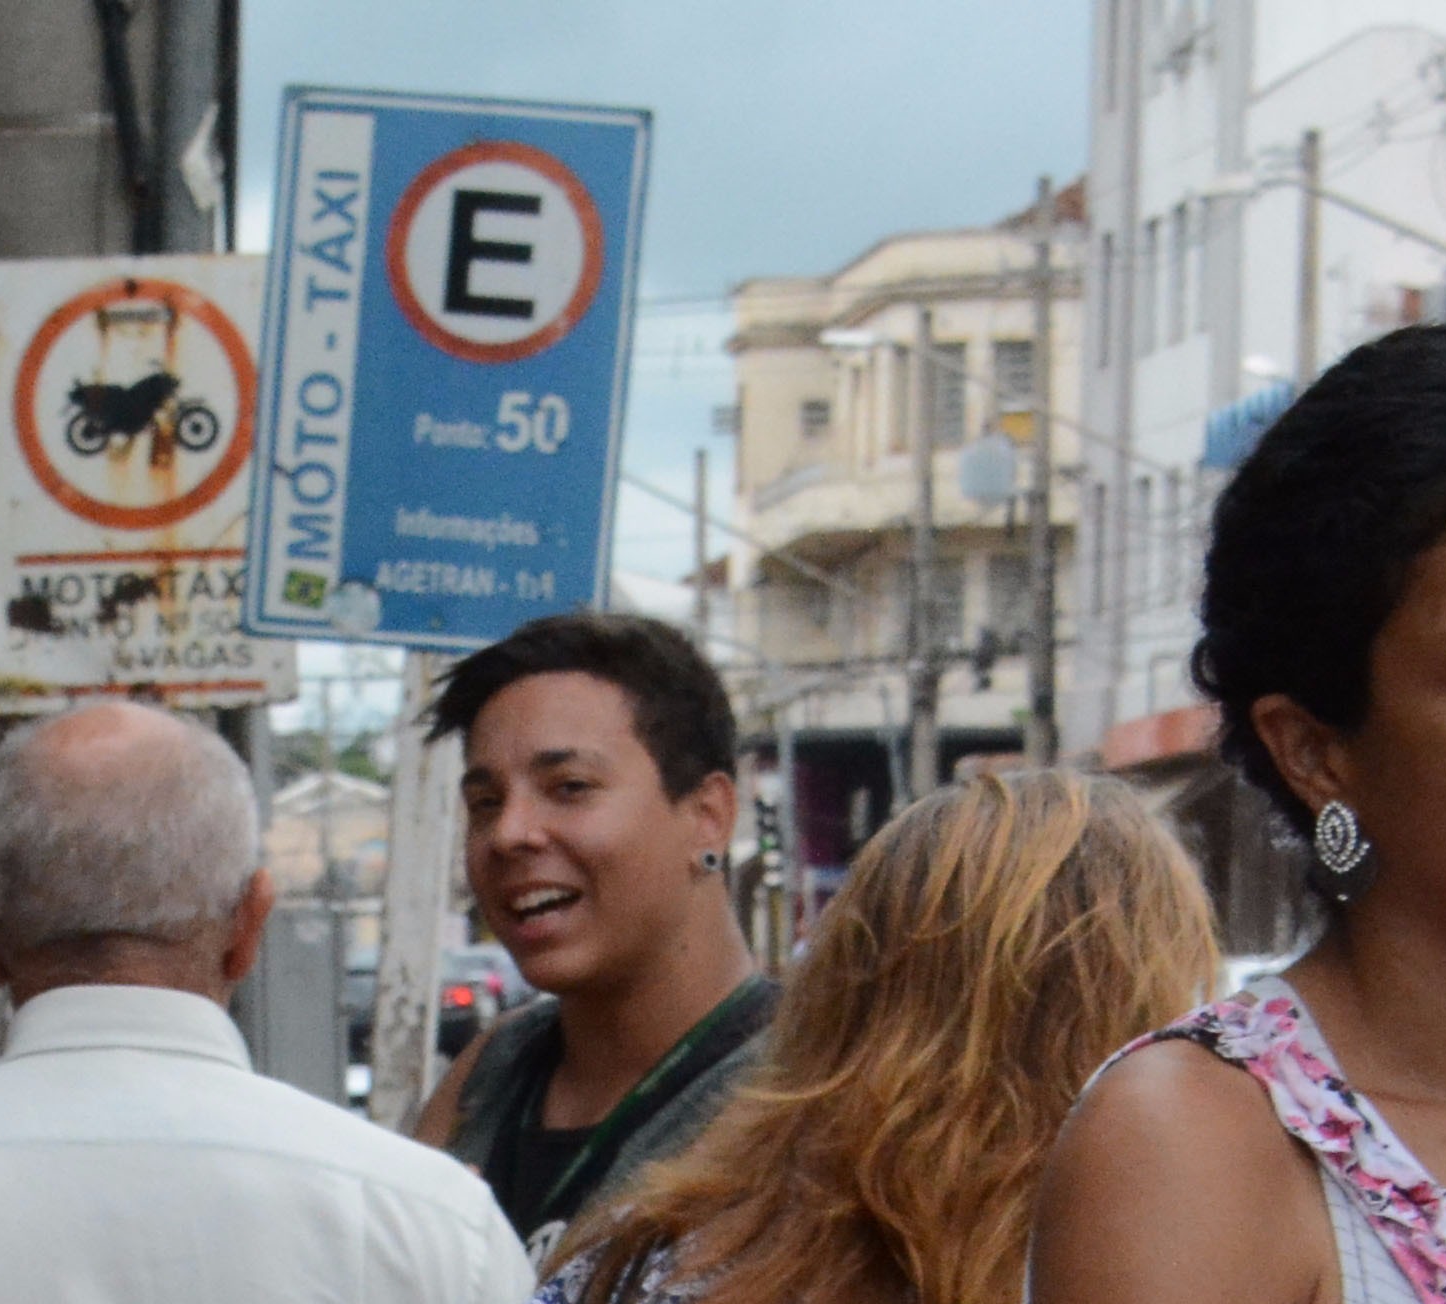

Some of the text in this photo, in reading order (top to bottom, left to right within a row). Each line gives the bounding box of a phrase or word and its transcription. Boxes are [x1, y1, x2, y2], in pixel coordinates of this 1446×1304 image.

[444, 189, 542, 319] E
[287, 371, 342, 561] MOTO
[496, 391, 570, 454] 50
[374, 560, 495, 597] AGETRAN
